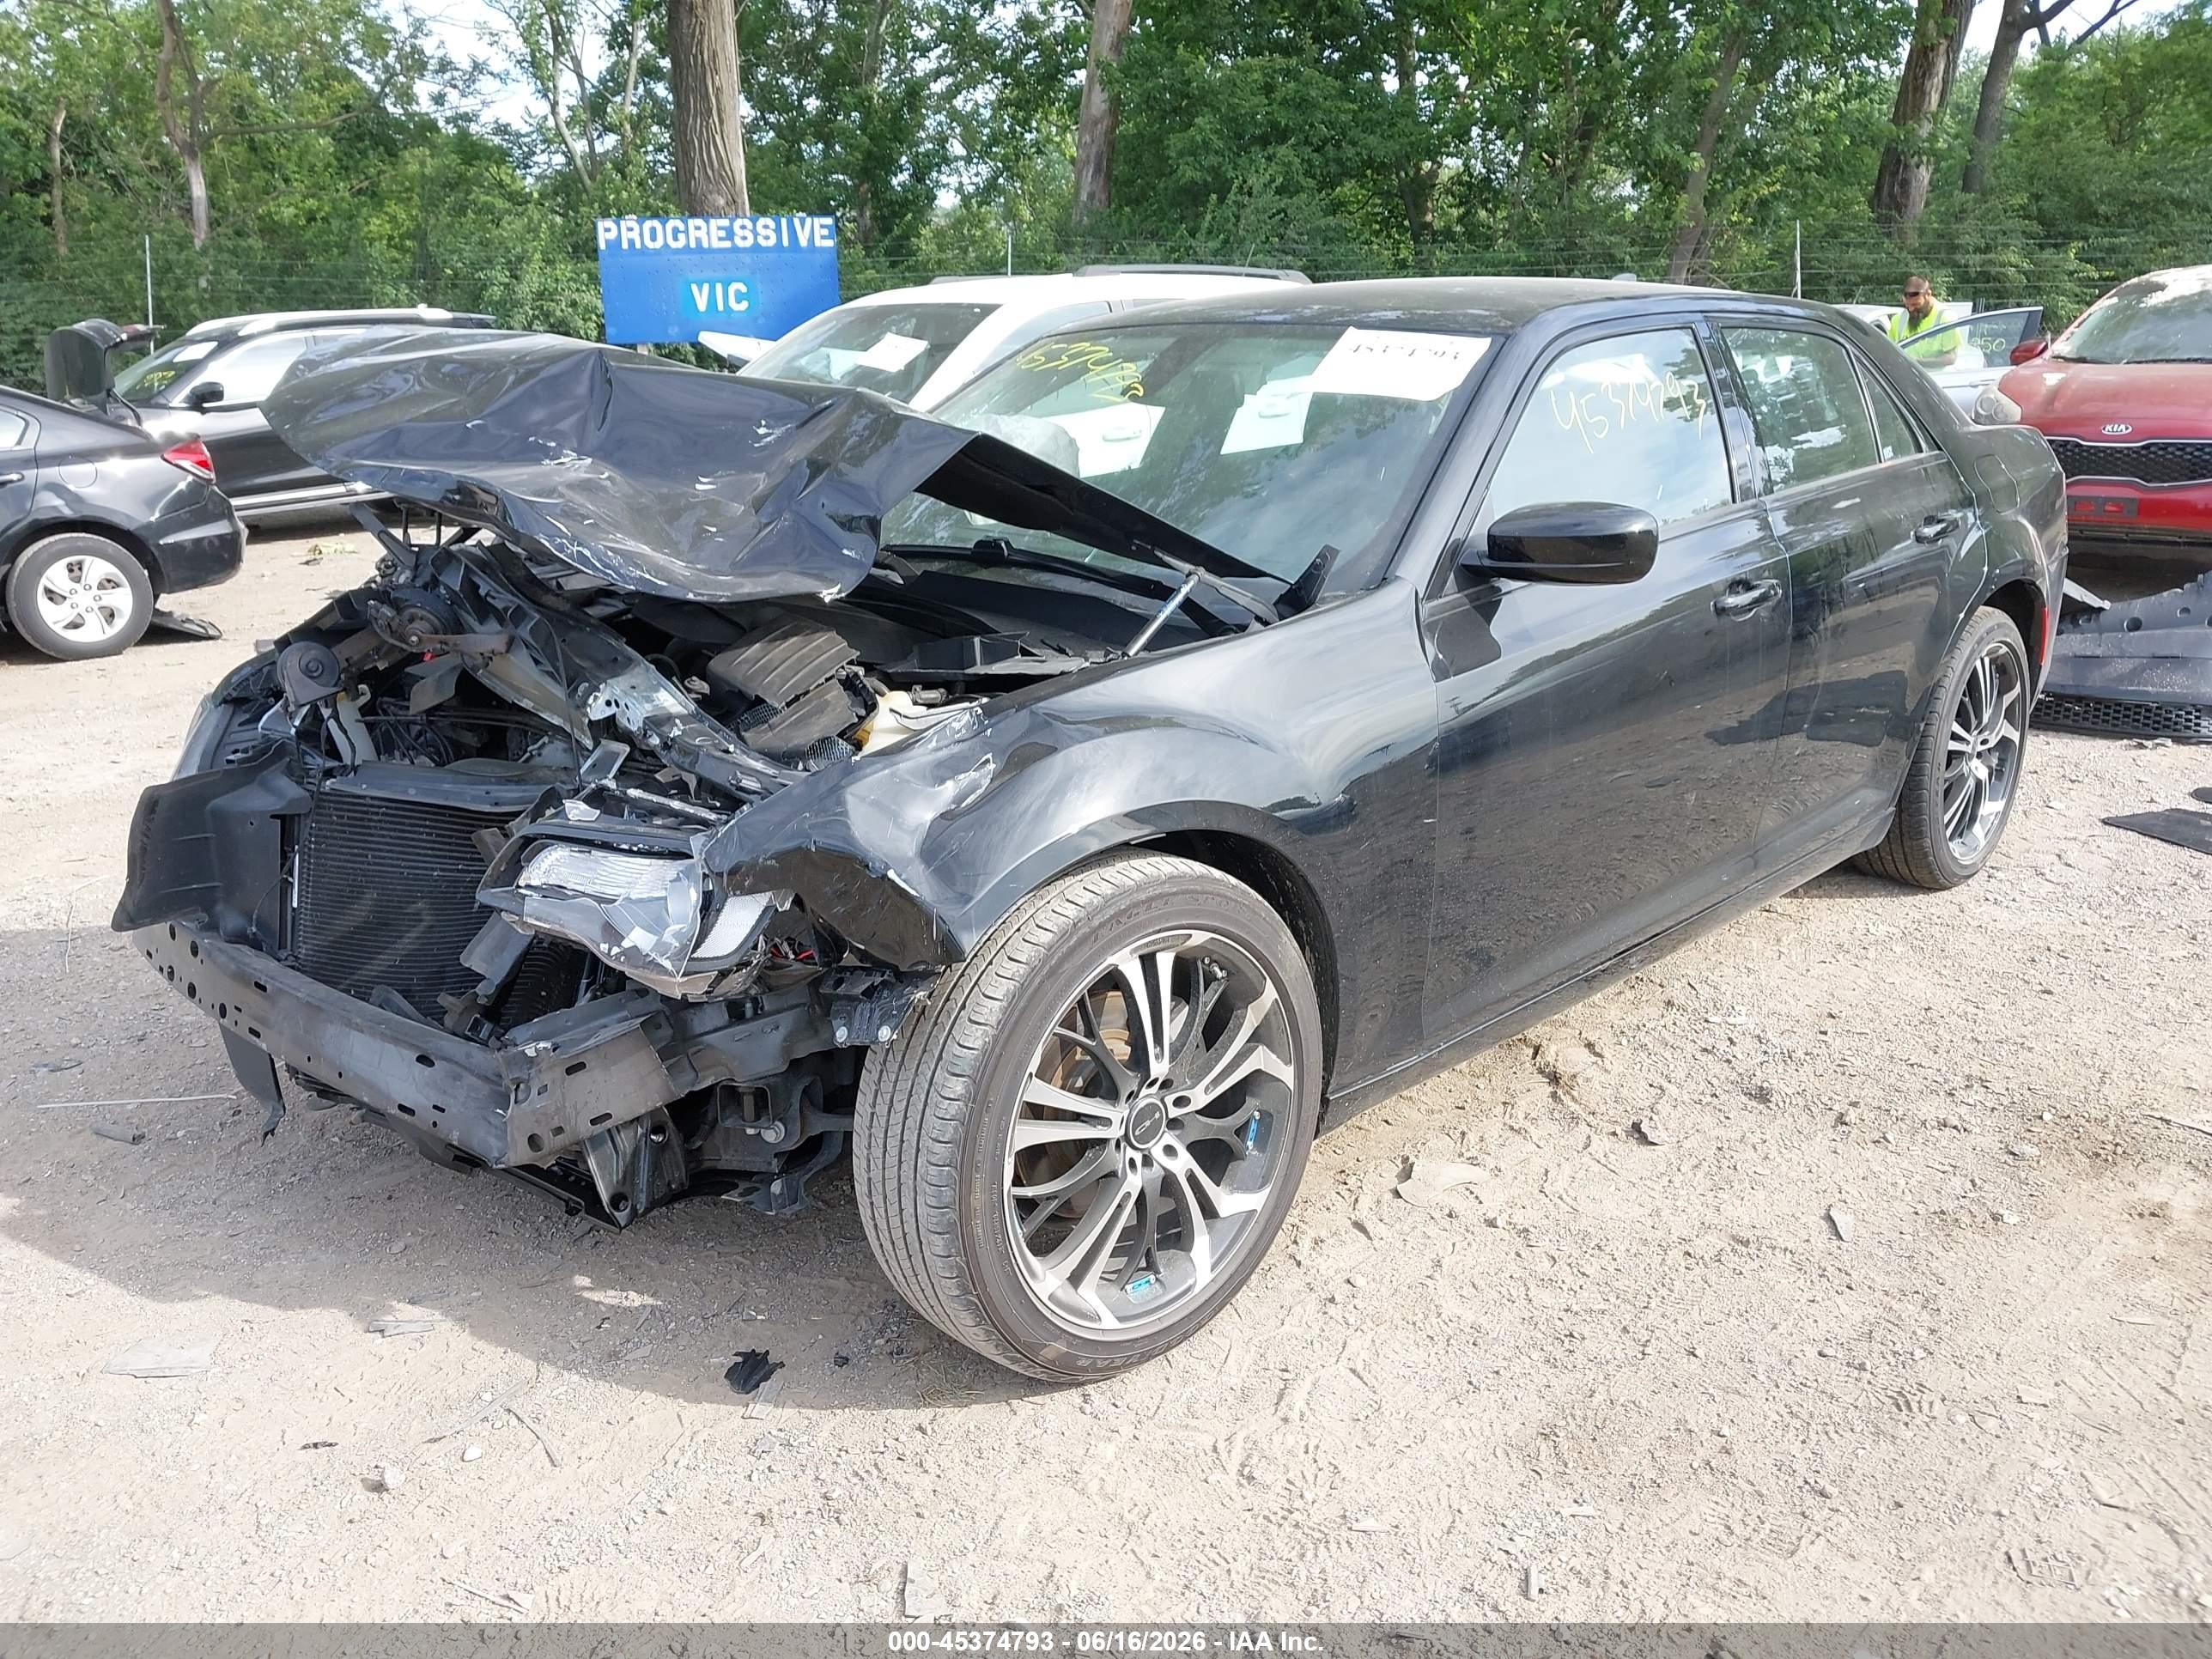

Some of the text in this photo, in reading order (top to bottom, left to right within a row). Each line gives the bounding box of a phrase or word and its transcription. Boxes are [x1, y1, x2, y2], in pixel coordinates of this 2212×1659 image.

[597, 216, 835, 250] PROGRESSIVE
[690, 281, 750, 312] VIC
[1550, 371, 1706, 453] 45374793
[2105, 423, 2127, 434] KIA
